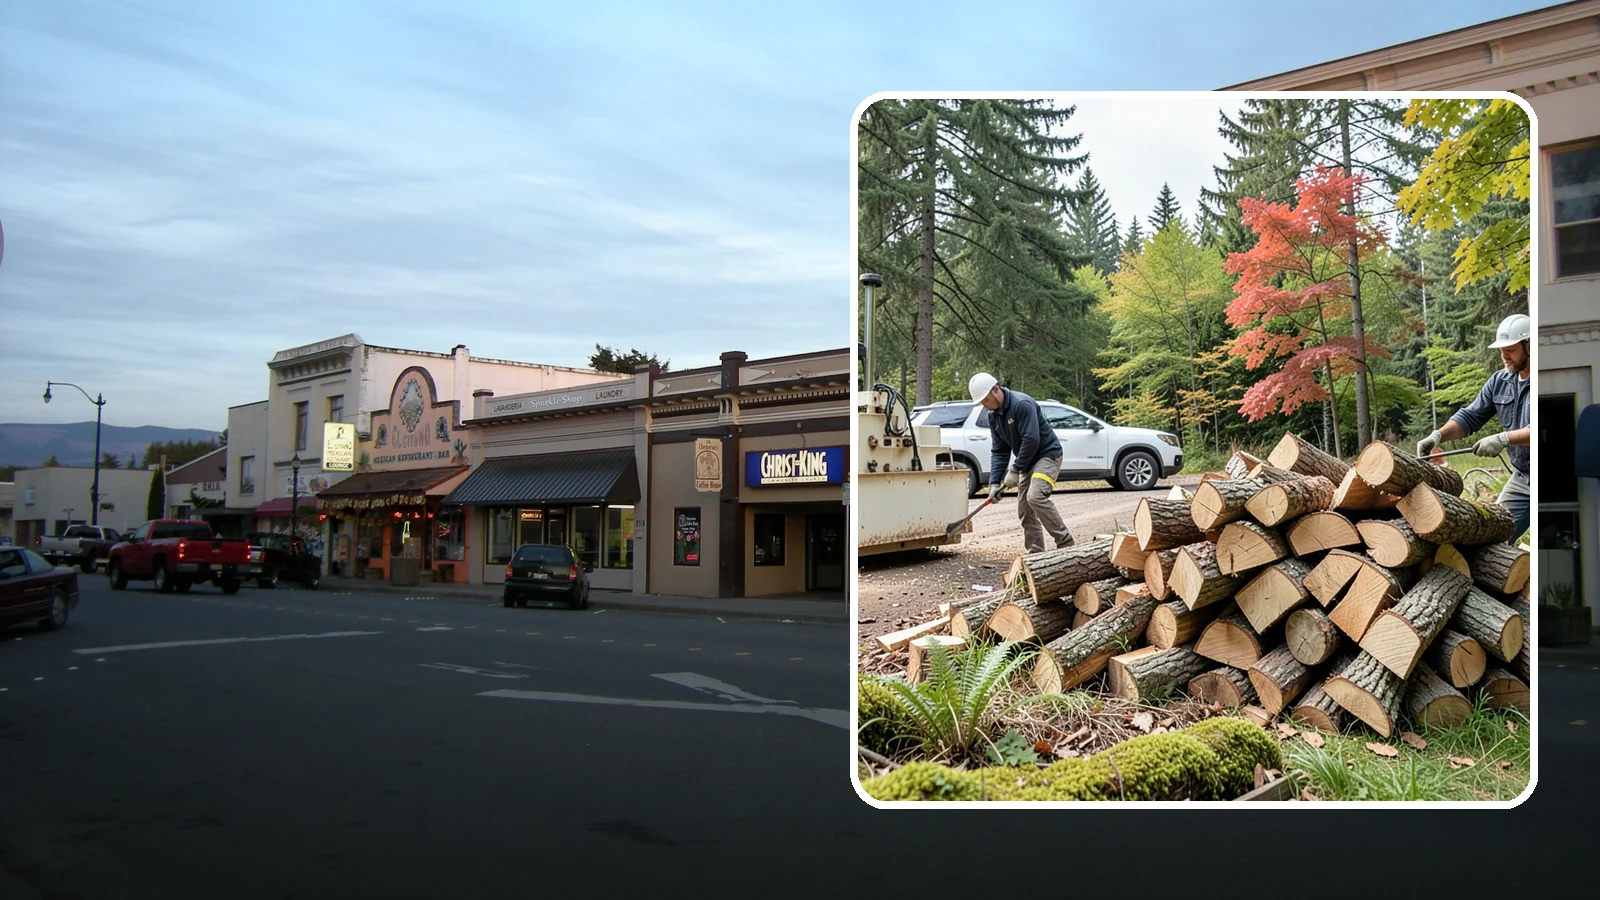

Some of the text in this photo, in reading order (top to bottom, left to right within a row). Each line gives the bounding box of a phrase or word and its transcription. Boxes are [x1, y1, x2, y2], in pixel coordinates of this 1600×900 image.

[595, 389, 623, 399] LAUNDRY
[493, 402, 523, 412] LAVANDERIA
[373, 450, 450, 464] MEXICAN RESTAURANT BAR
[761, 450, 827, 478] CHRIST KING
[696, 481, 722, 489] Coffee House
